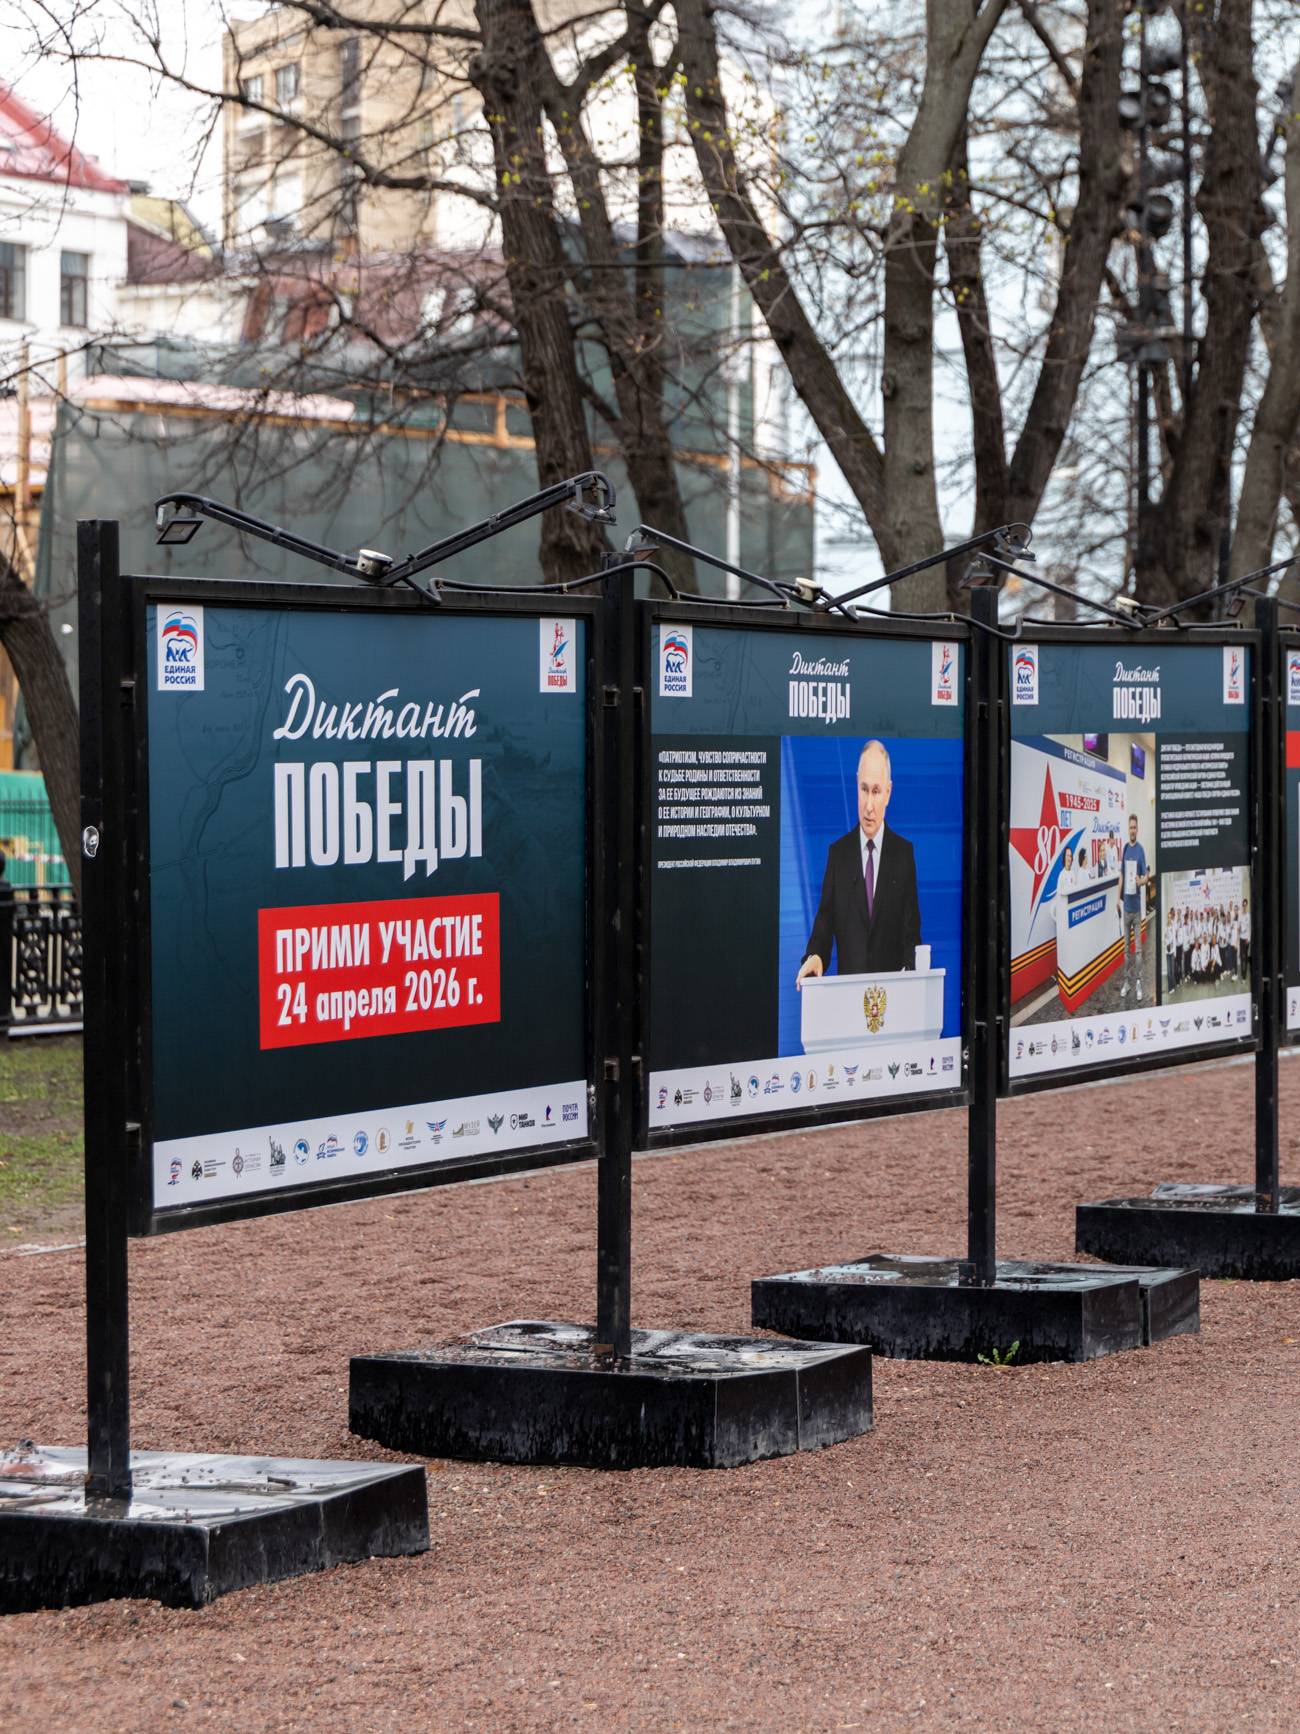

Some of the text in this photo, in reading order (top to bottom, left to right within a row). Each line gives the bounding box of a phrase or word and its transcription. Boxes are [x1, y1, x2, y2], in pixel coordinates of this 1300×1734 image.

[164, 665, 196, 674] ЕДИНАЯ
[164, 675, 196, 685] РОССИЯ
[664, 675, 687, 684] ЕДИНАЯ
[789, 651, 850, 676] Диктант
[1113, 660, 1161, 682] Диктант
[273, 672, 481, 741] Диктант
[664, 683, 687, 693] РОССИЯ
[788, 681, 851, 725] ПОБЕДЫ
[1112, 687, 1161, 724] ПОБЕДЫ
[274, 758, 483, 882] ПОБЕДЫ
[1033, 825, 1061, 875] 80
[275, 914, 484, 974] ПРИМИ УЧАСТИЕ
[277, 967, 484, 1032] 24 апреля 2026 г.
